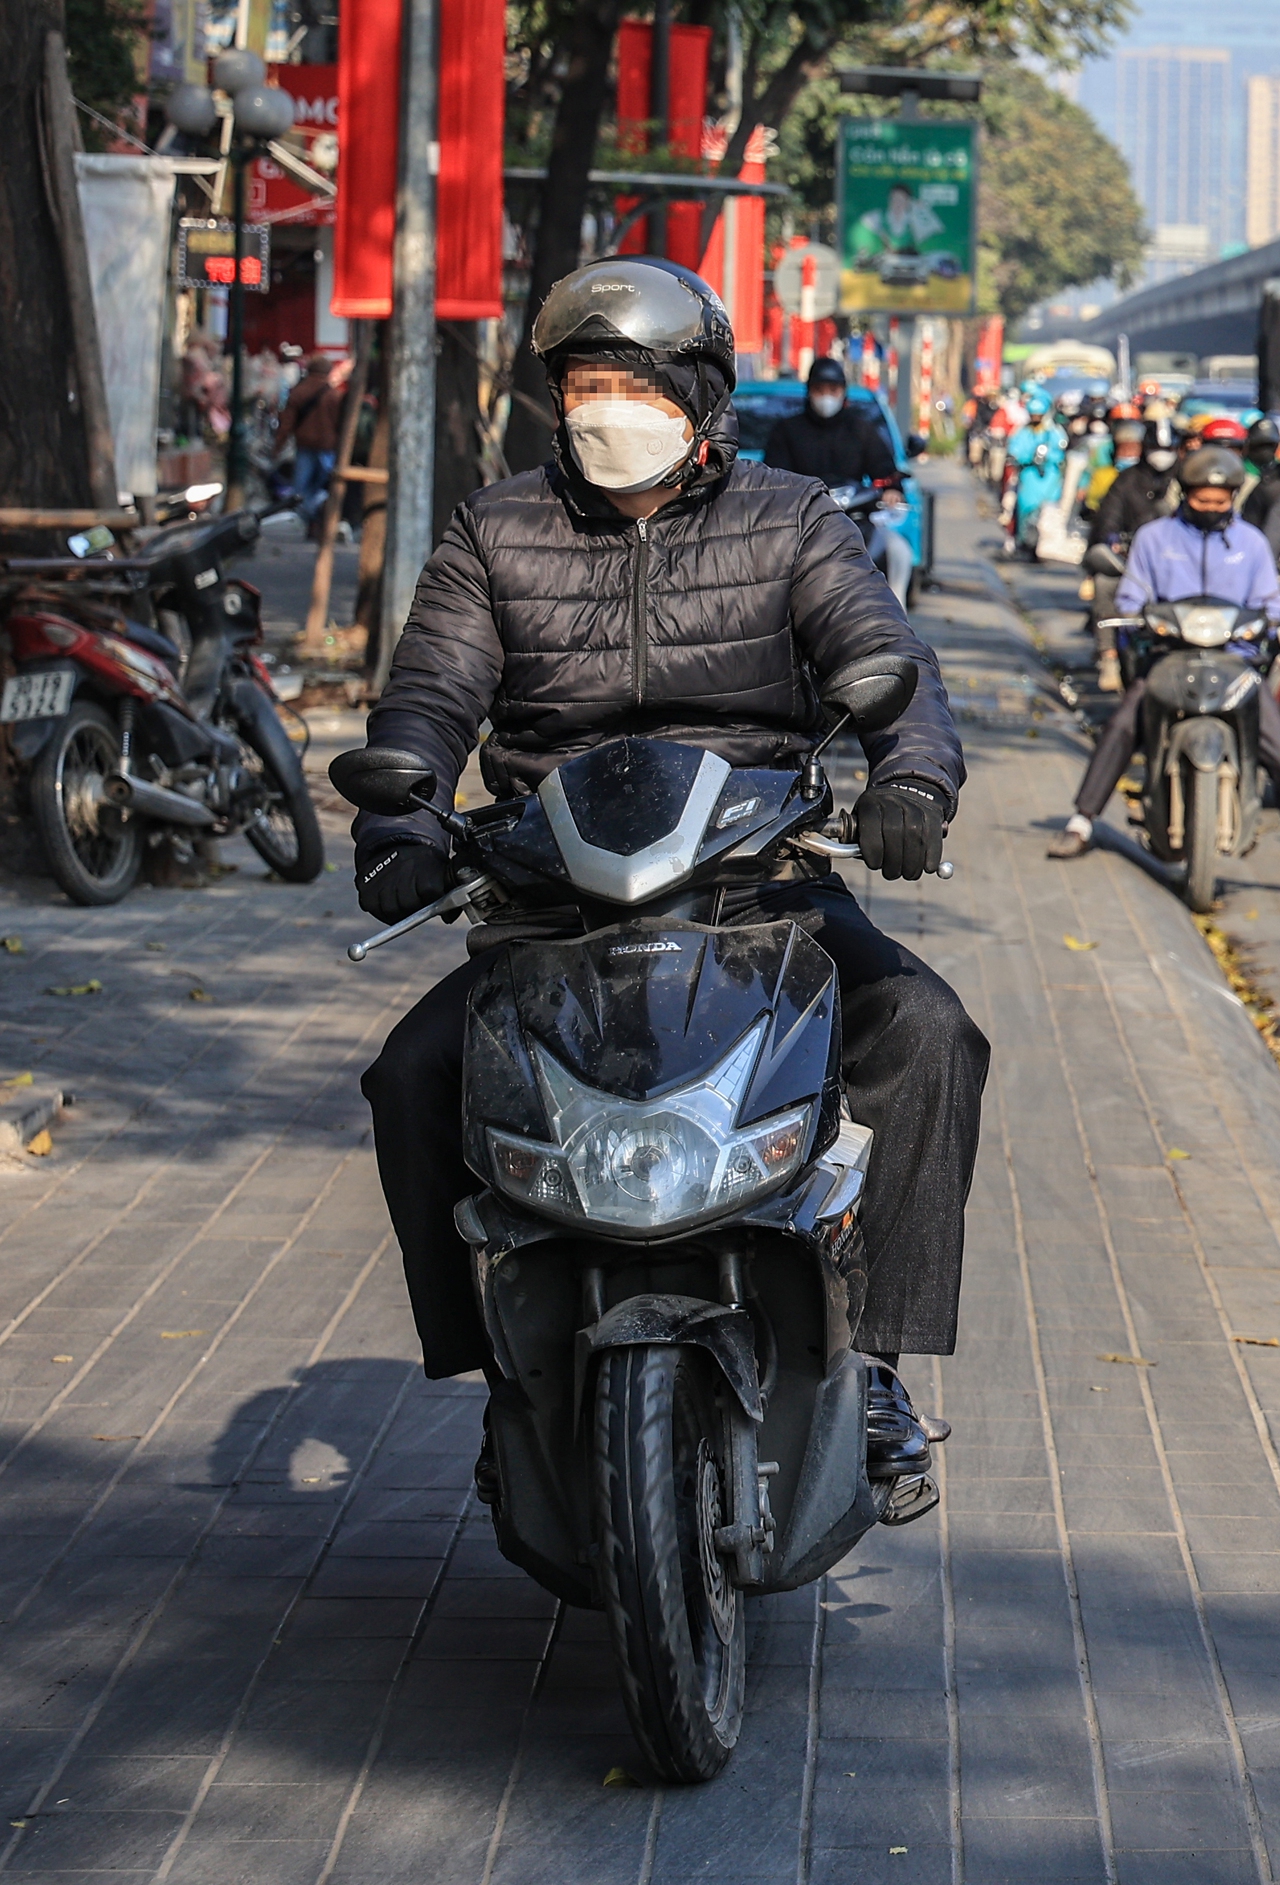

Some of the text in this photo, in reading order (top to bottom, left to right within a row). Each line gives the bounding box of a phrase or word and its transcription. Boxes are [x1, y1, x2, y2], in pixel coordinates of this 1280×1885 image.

[591, 284, 635, 293] Sport
[364, 850, 398, 884] SPORT
[608, 942, 682, 956] HONDA
